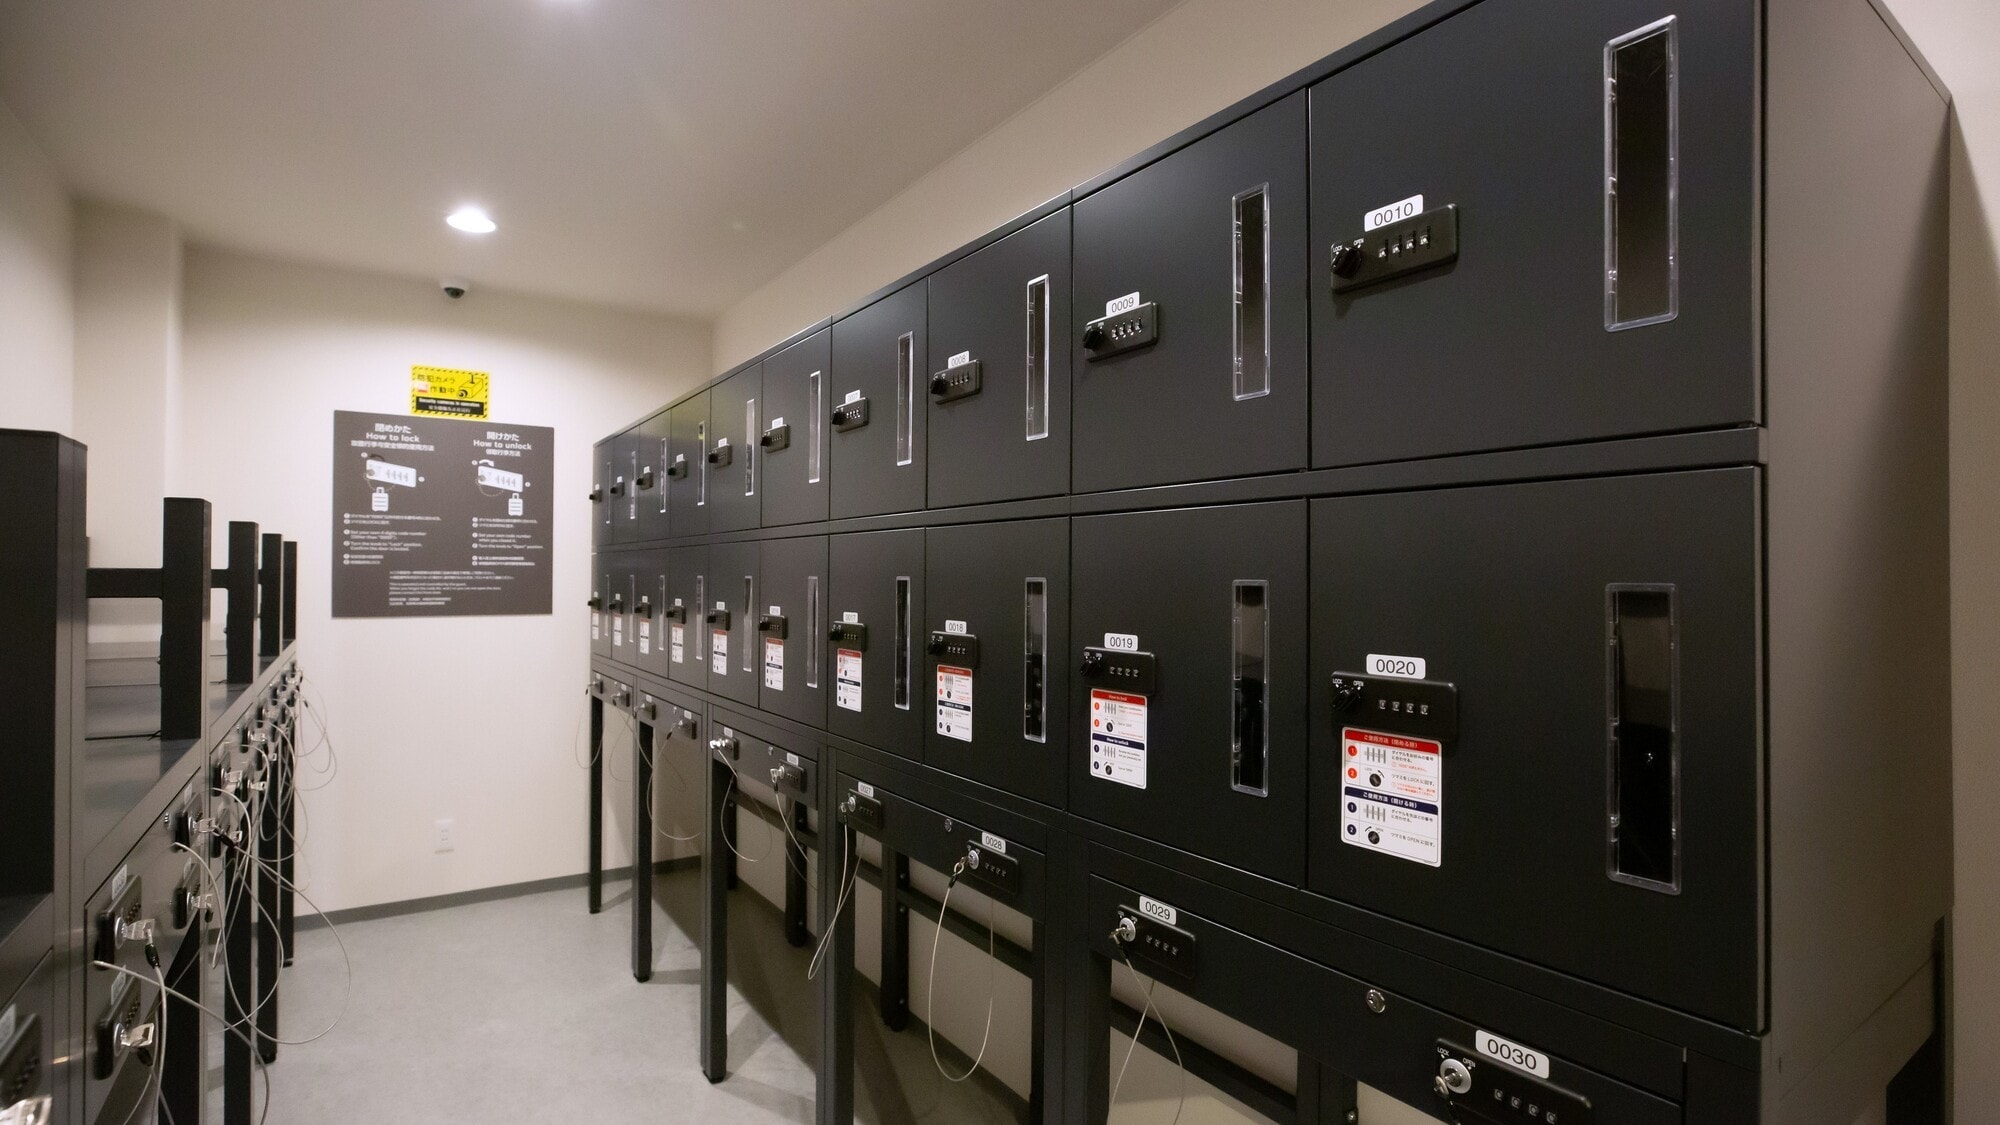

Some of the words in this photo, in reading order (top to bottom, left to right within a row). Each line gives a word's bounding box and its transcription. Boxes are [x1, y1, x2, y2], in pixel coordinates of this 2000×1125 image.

[1374, 203, 1413, 226] 0010
[1112, 297, 1134, 313] 0009
[505, 442, 532, 450] unlock
[949, 623, 963, 632] 0018
[1110, 637, 1132, 648] 0019
[1376, 659, 1416, 675] 0020
[985, 836, 1002, 850] 0028
[1145, 901, 1170, 920] 0029
[1437, 1047, 1450, 1056] LOCK
[1488, 1039, 1536, 1070] 0030
[1462, 1058, 1476, 1067] OPEN
